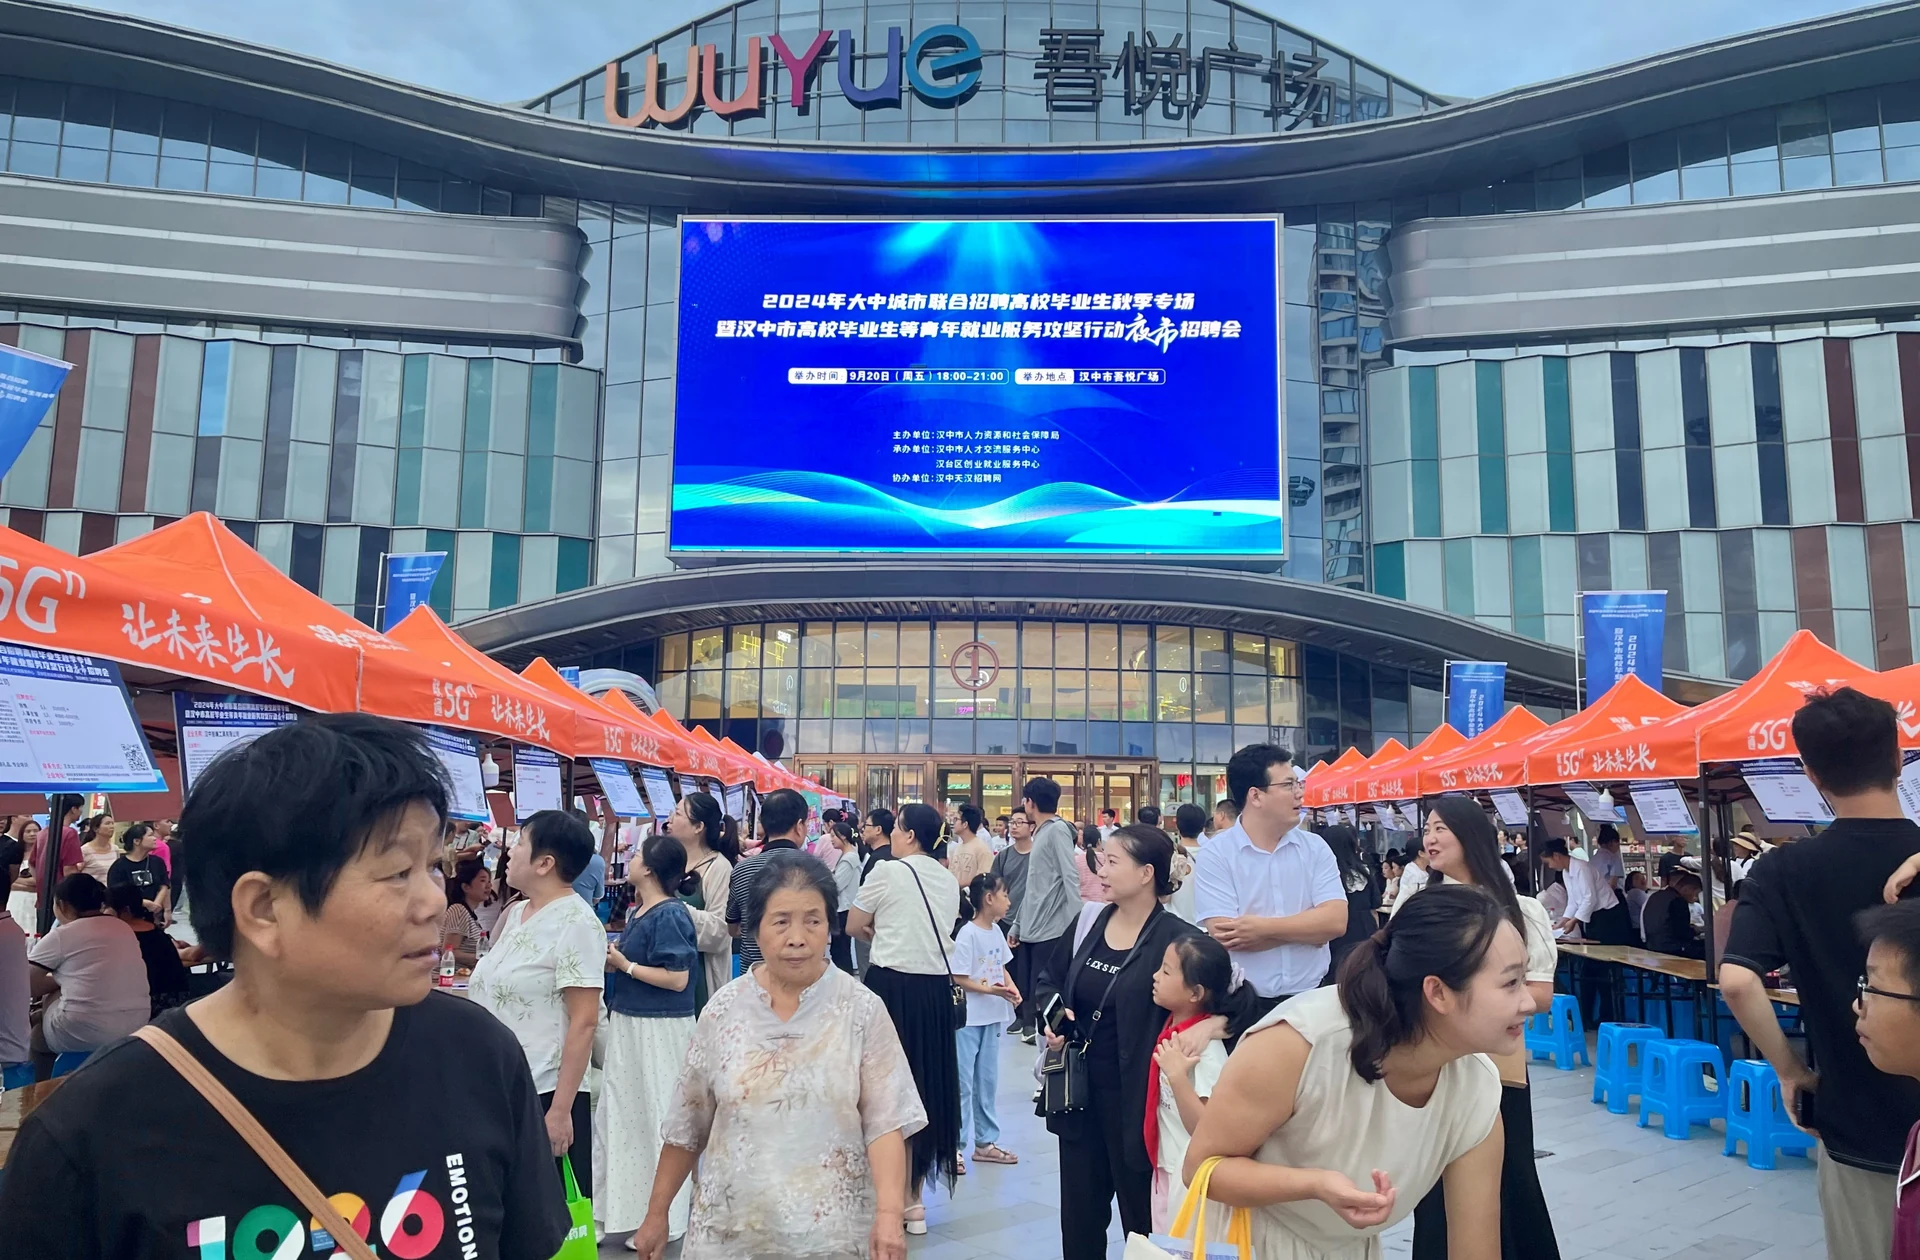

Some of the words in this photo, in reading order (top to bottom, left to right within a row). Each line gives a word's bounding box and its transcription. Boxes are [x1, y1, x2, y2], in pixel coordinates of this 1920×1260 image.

[1034, 28, 1338, 130] 吾悦广场
[762, 292, 1195, 311] 2024年大中城市联合招聘高校毕业生秋季专场
[1079, 371, 1160, 383] 汉中市吾悦广场
[936, 459, 1040, 469] 汉台区创业就业服务中心
[121, 601, 296, 689] 让未来生长
